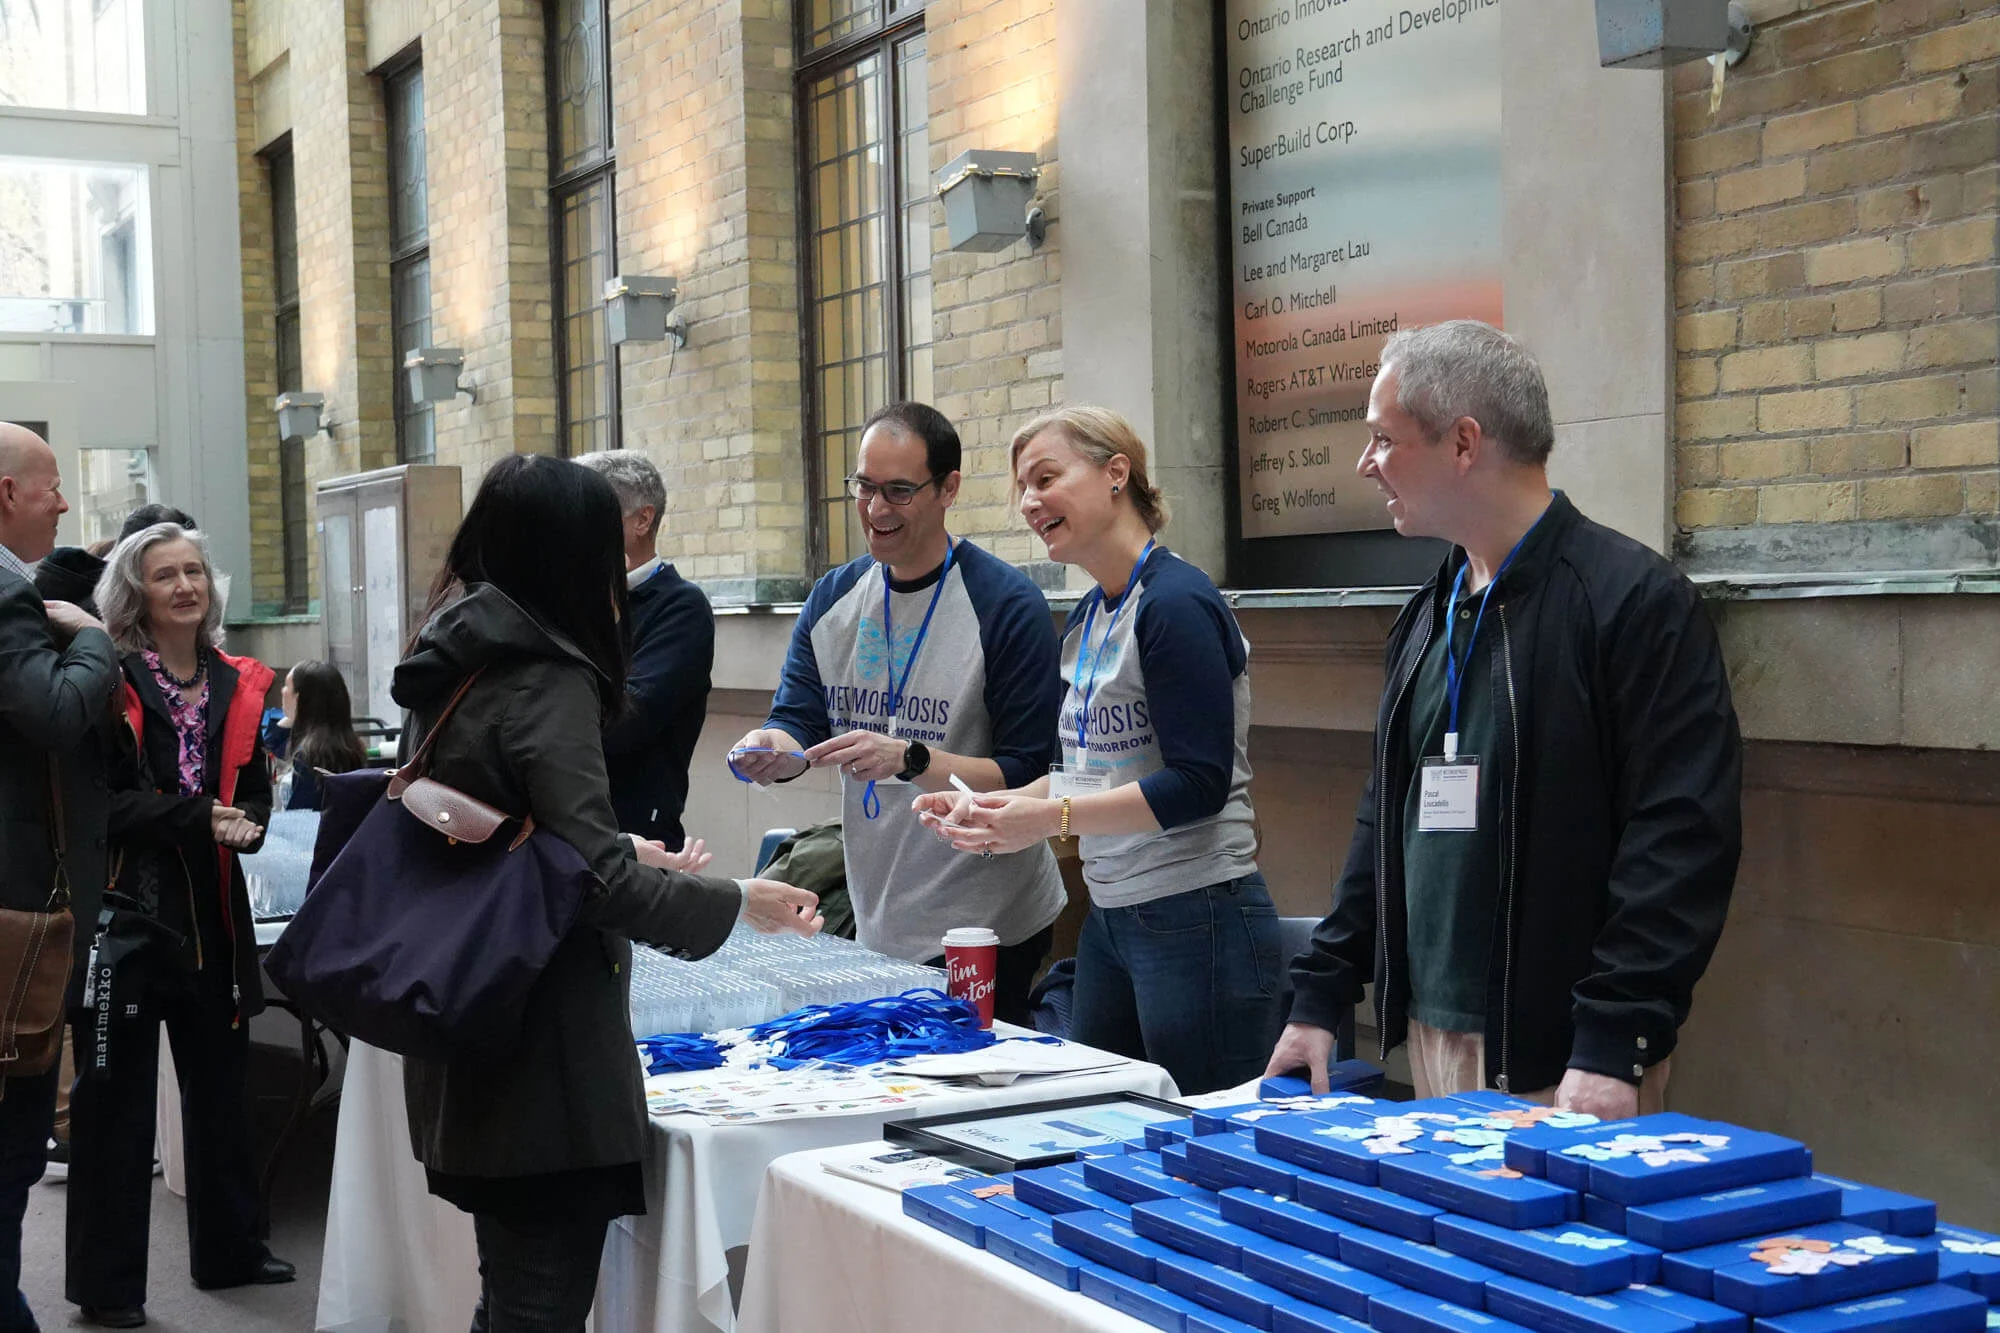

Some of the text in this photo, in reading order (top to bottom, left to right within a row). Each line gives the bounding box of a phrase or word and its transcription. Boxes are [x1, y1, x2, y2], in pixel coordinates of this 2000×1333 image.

[1238, 8, 1290, 41] Ontario
[1239, 58, 1291, 89] Ontario
[1296, 29, 1361, 69] Research
[1366, 16, 1393, 47] and
[1240, 60, 1343, 114] Challenge Fund
[1240, 120, 1358, 169] SuperBuild Corp.
[1242, 186, 1316, 216] Private Support
[1242, 212, 1308, 244] Bell Canada
[1243, 240, 1370, 282] Lee and Margaret Lau
[1244, 285, 1336, 320] Carl O. Mitchell
[1246, 312, 1398, 359] Motorola Canada Limited
[1247, 360, 1382, 399] Rogers AT&T Wireles
[1249, 413, 1288, 435] Robert
[1291, 408, 1305, 428] C.
[1250, 447, 1330, 478] Jeffrey S. Skoll
[1251, 488, 1336, 515] Greg Wolfond
[946, 956, 978, 985] Tim
[95, 967, 112, 1068] marimekko
